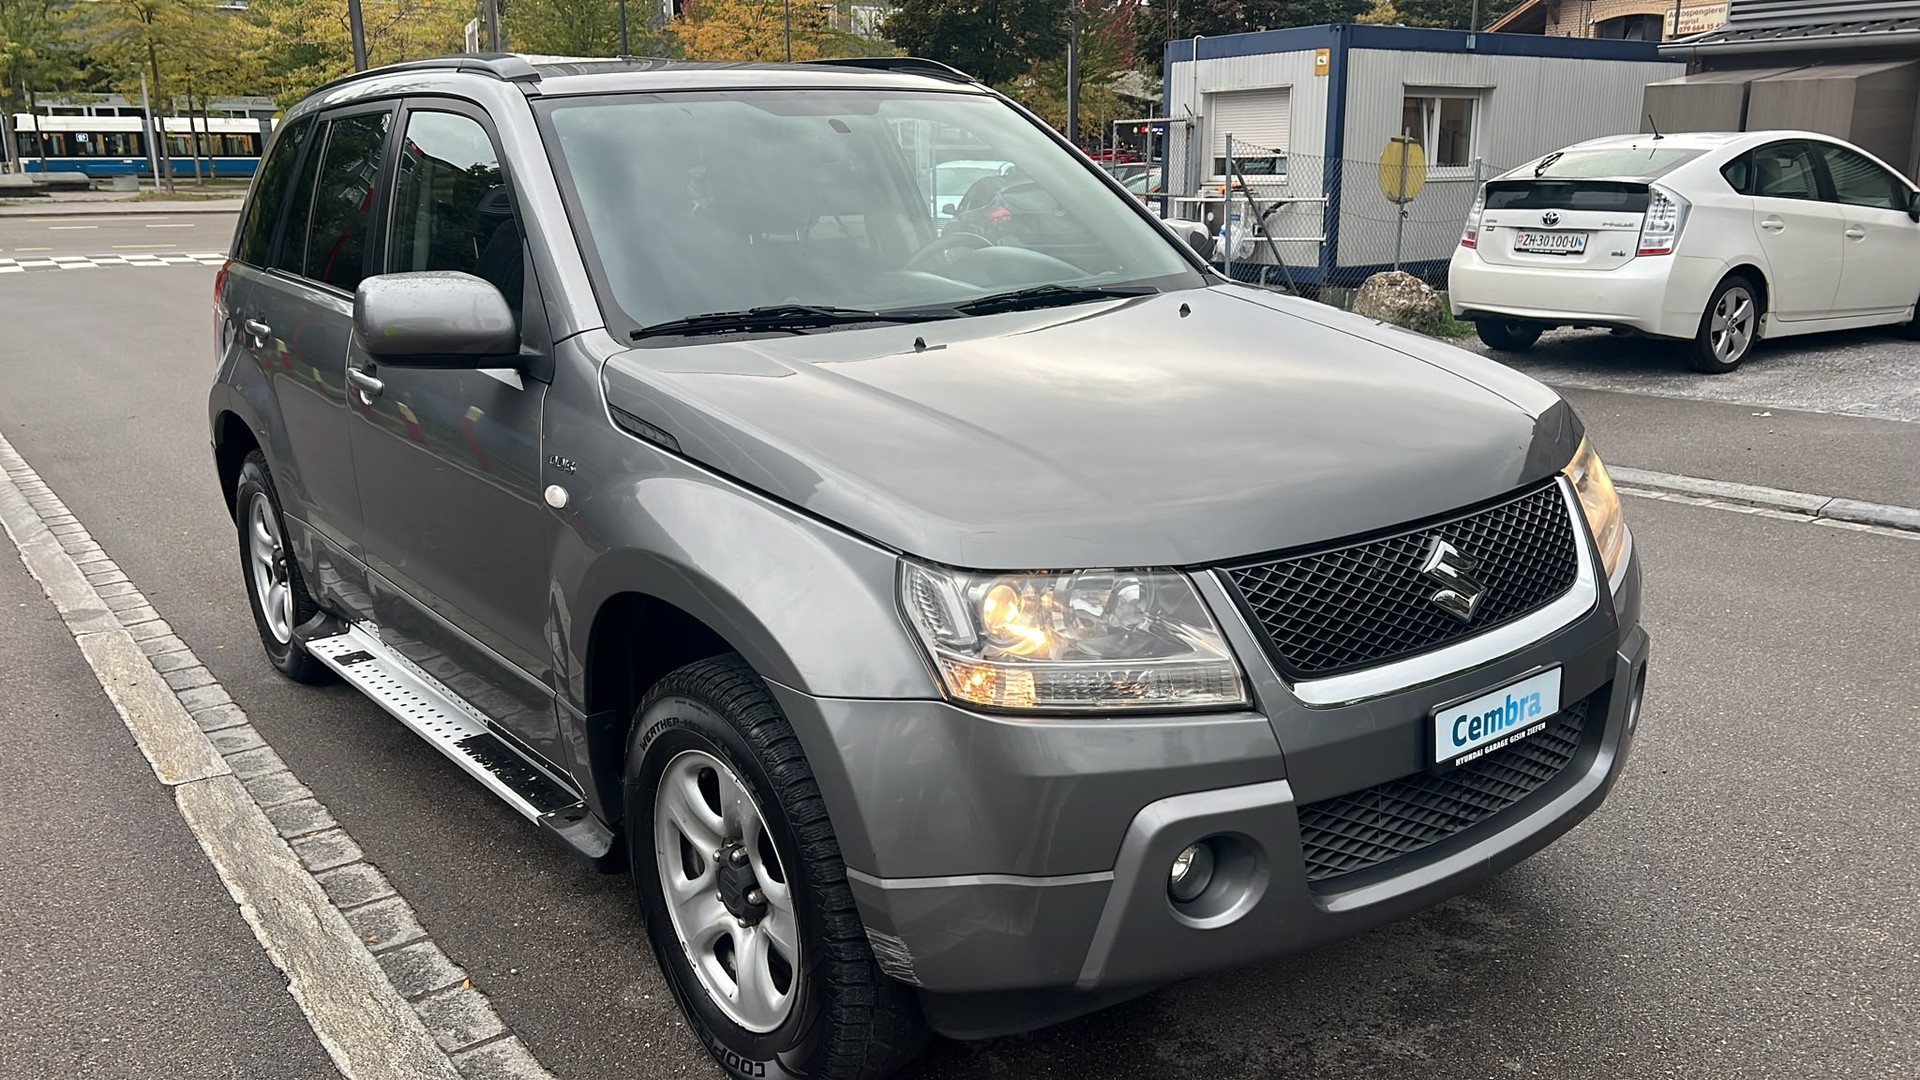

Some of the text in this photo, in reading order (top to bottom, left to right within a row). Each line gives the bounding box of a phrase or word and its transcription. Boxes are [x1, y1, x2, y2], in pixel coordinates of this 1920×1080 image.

[1668, 7, 1726, 18] Aospenglerei
[1679, 25, 1691, 33] 079
[1692, 23, 1705, 31] 664
[1452, 691, 1542, 747] Cembra
[1455, 722, 1546, 766] HYUNDAI GARAGE GISIN ZIEFEN
